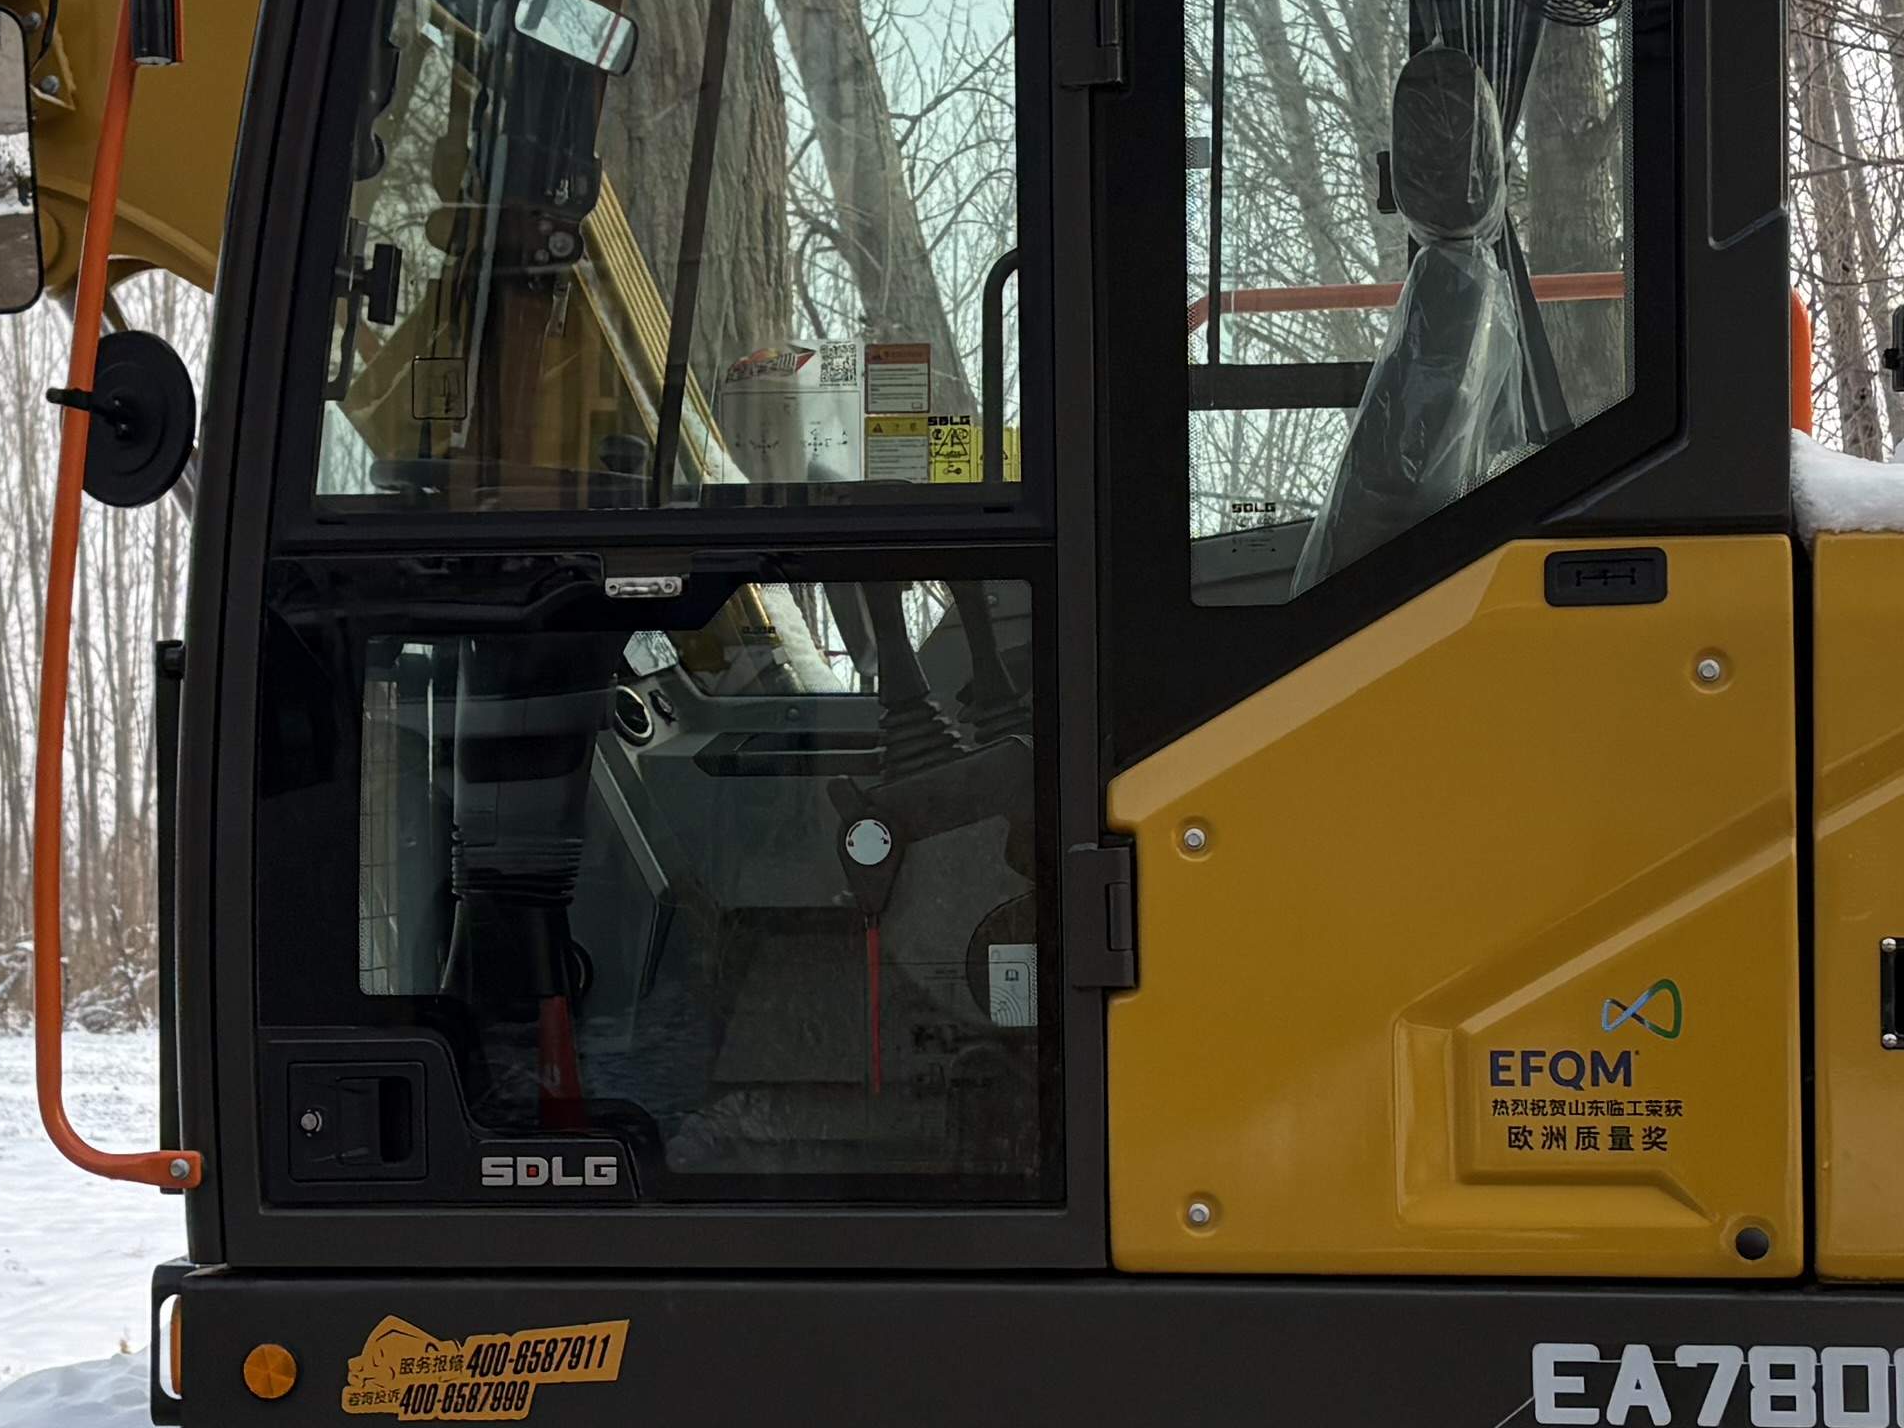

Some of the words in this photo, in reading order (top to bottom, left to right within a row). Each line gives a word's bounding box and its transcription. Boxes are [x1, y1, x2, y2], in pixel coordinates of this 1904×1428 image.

[928, 416, 971, 426] SDLG
[1489, 1050, 1633, 1091] EFQM
[1492, 1099, 1683, 1117] 热烈祝贺山东临工荣获
[1507, 1125, 1668, 1151] 欧洲质量奖
[482, 1155, 618, 1186] SDLG
